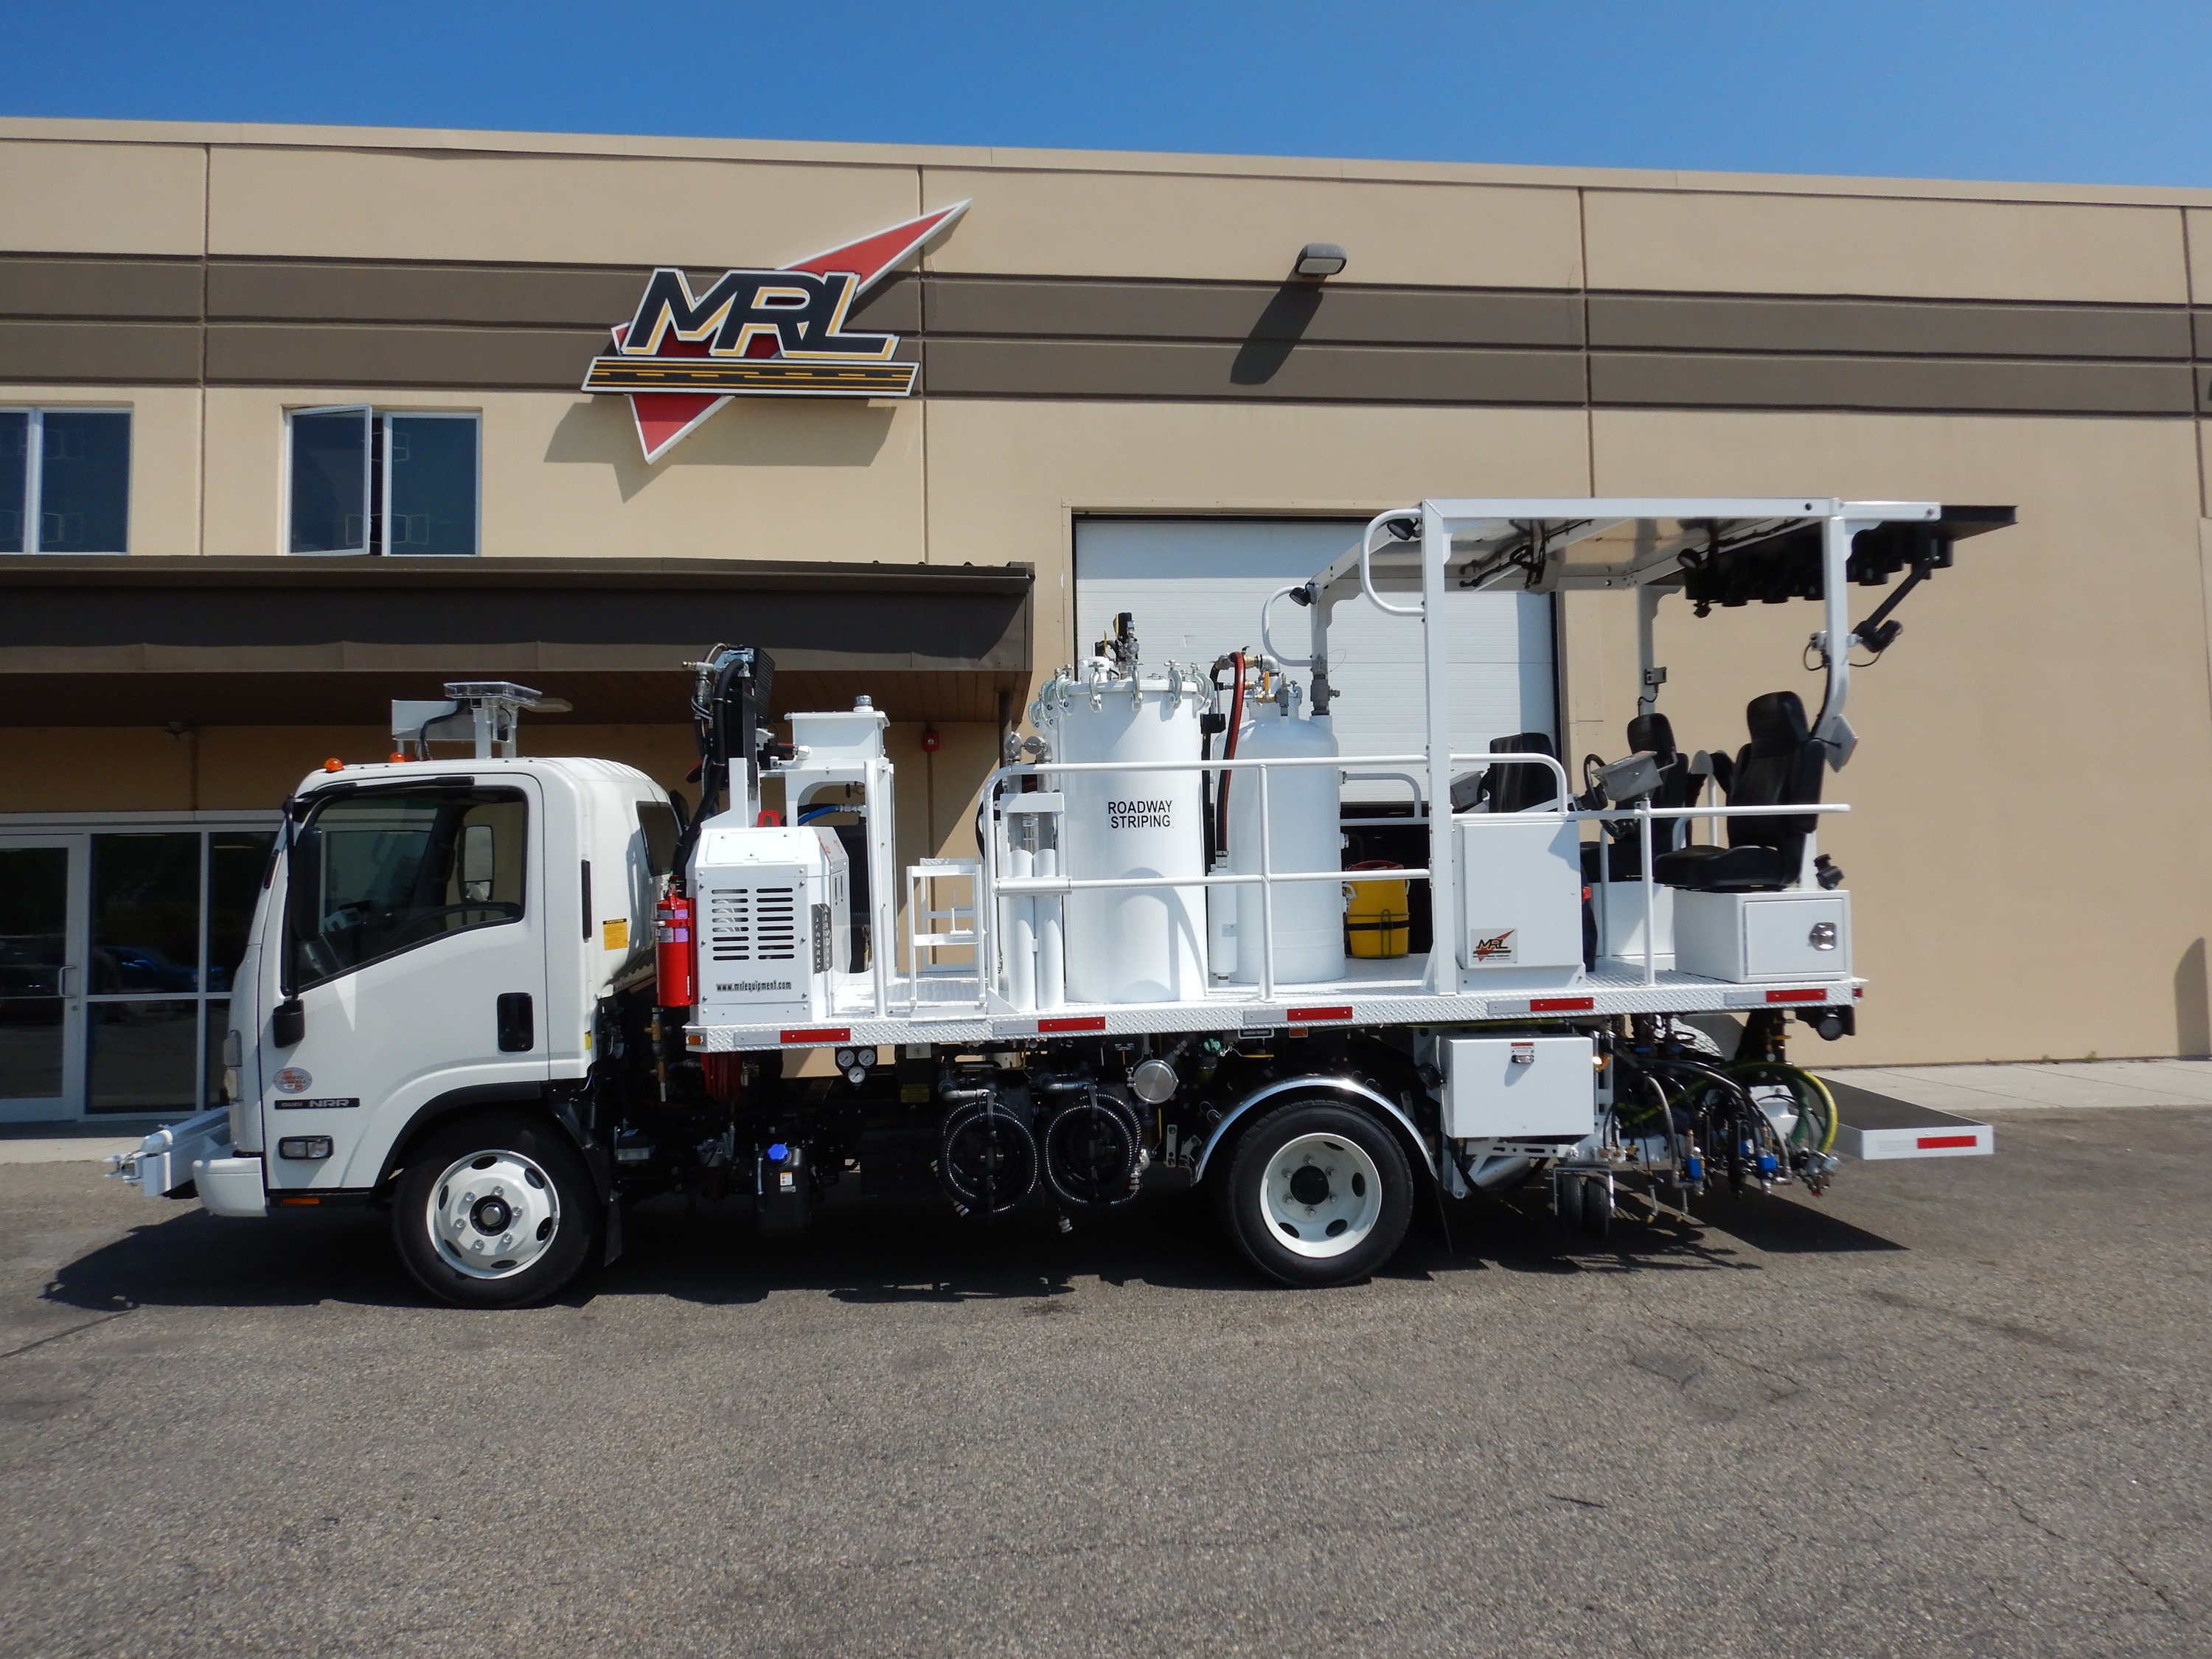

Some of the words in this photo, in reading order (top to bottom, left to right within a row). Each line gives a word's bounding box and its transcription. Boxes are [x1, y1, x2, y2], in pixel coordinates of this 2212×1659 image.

[620, 267, 900, 361] MRL
[1107, 800, 1172, 814] ROADWAY
[1110, 815, 1171, 829] STRIPING
[1475, 939, 1509, 950] MRL
[716, 980, 792, 992] www.mrlequipment.com
[309, 1099, 349, 1107] NRR
